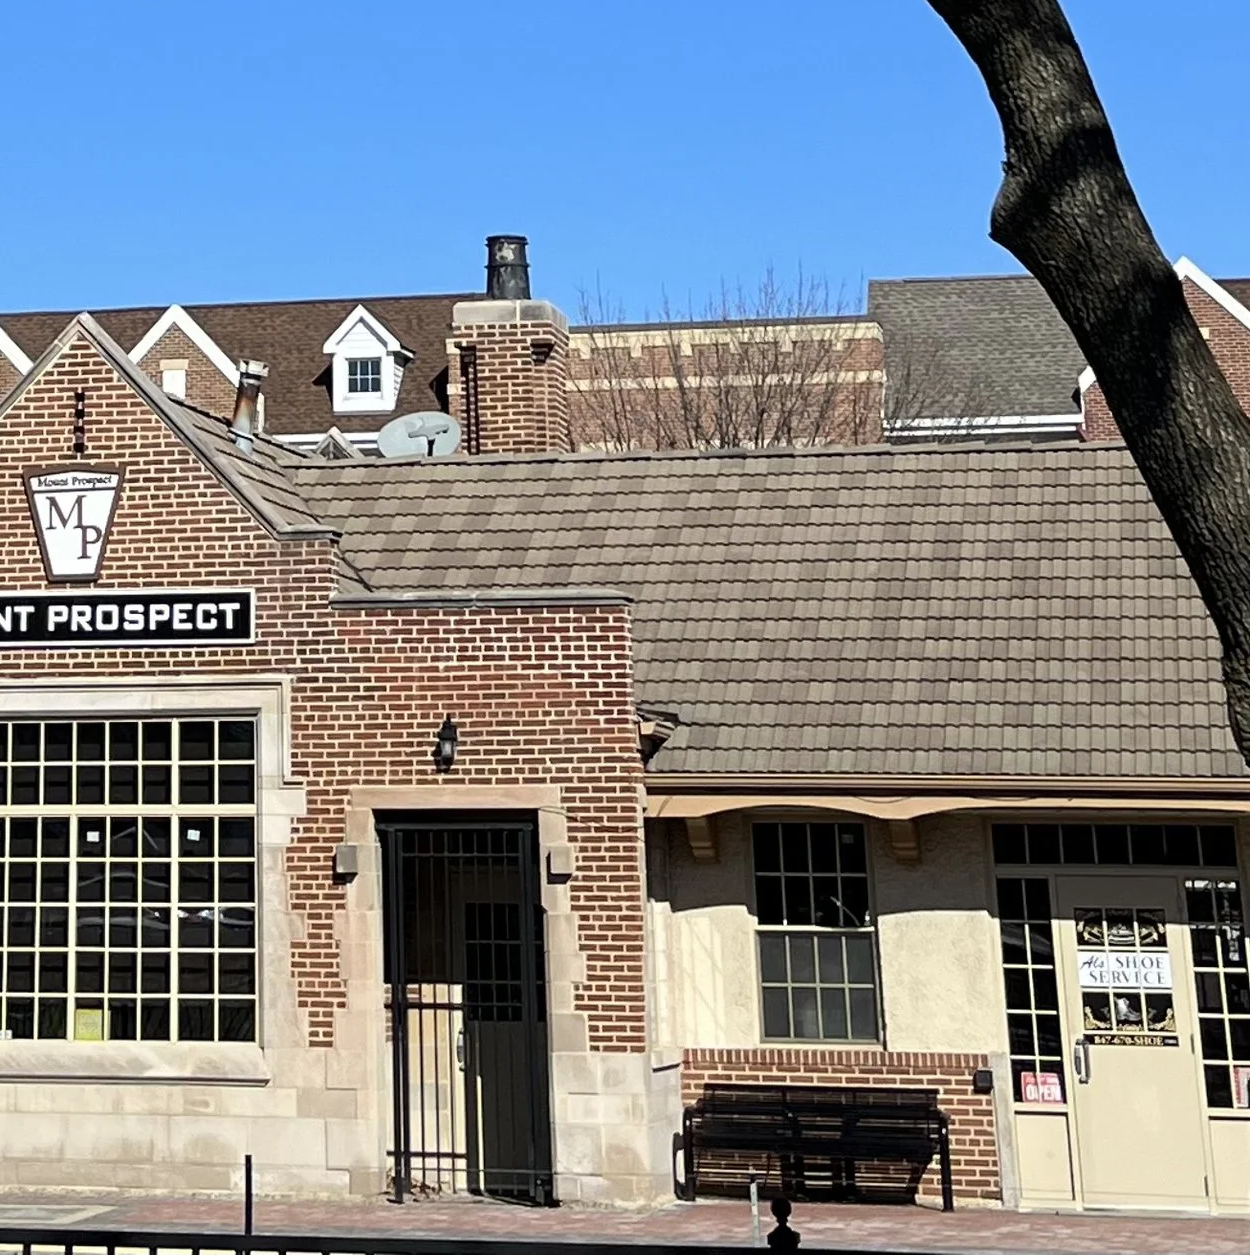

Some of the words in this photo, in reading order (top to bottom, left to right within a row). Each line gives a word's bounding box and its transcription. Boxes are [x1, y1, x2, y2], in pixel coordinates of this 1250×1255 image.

[37, 477, 69, 487] Mount
[71, 475, 112, 488] Prospect
[47, 602, 241, 632] PROSPECT
[1114, 955, 1165, 970] SHOE
[1088, 970, 1166, 985] SERVICE
[1025, 1083, 1062, 1102] OPEN
